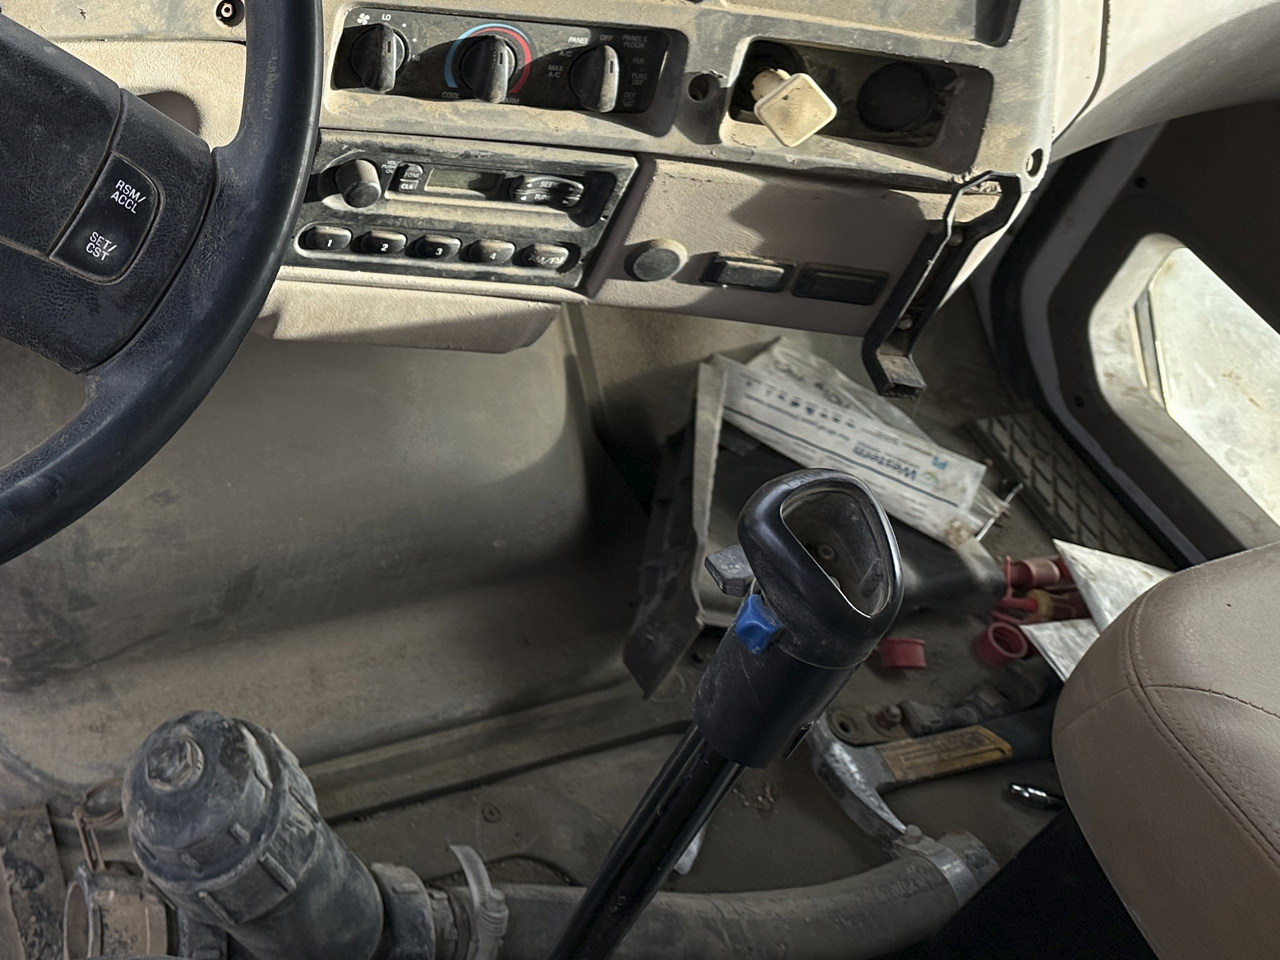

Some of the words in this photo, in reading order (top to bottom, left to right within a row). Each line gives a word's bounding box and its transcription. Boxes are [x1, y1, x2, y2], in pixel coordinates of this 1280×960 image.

[381, 13, 392, 21] LO
[567, 36, 589, 44] PANEL
[622, 35, 644, 43] PANEL
[623, 41, 646, 49] FLOOR
[558, 50, 573, 58] A/C
[632, 57, 645, 65] FLR
[548, 64, 564, 72] MAX
[547, 71, 561, 79] A/C
[441, 91, 460, 100] COOL
[114, 179, 147, 203] RSM/
[110, 190, 137, 214] ACCL
[89, 231, 117, 252] SET/
[327, 239, 332, 248] 1
[85, 242, 109, 261] CST
[381, 243, 389, 252] 2
[435, 247, 443, 256] 3
[490, 252, 497, 261] 4
[852, 442, 918, 481] Western
